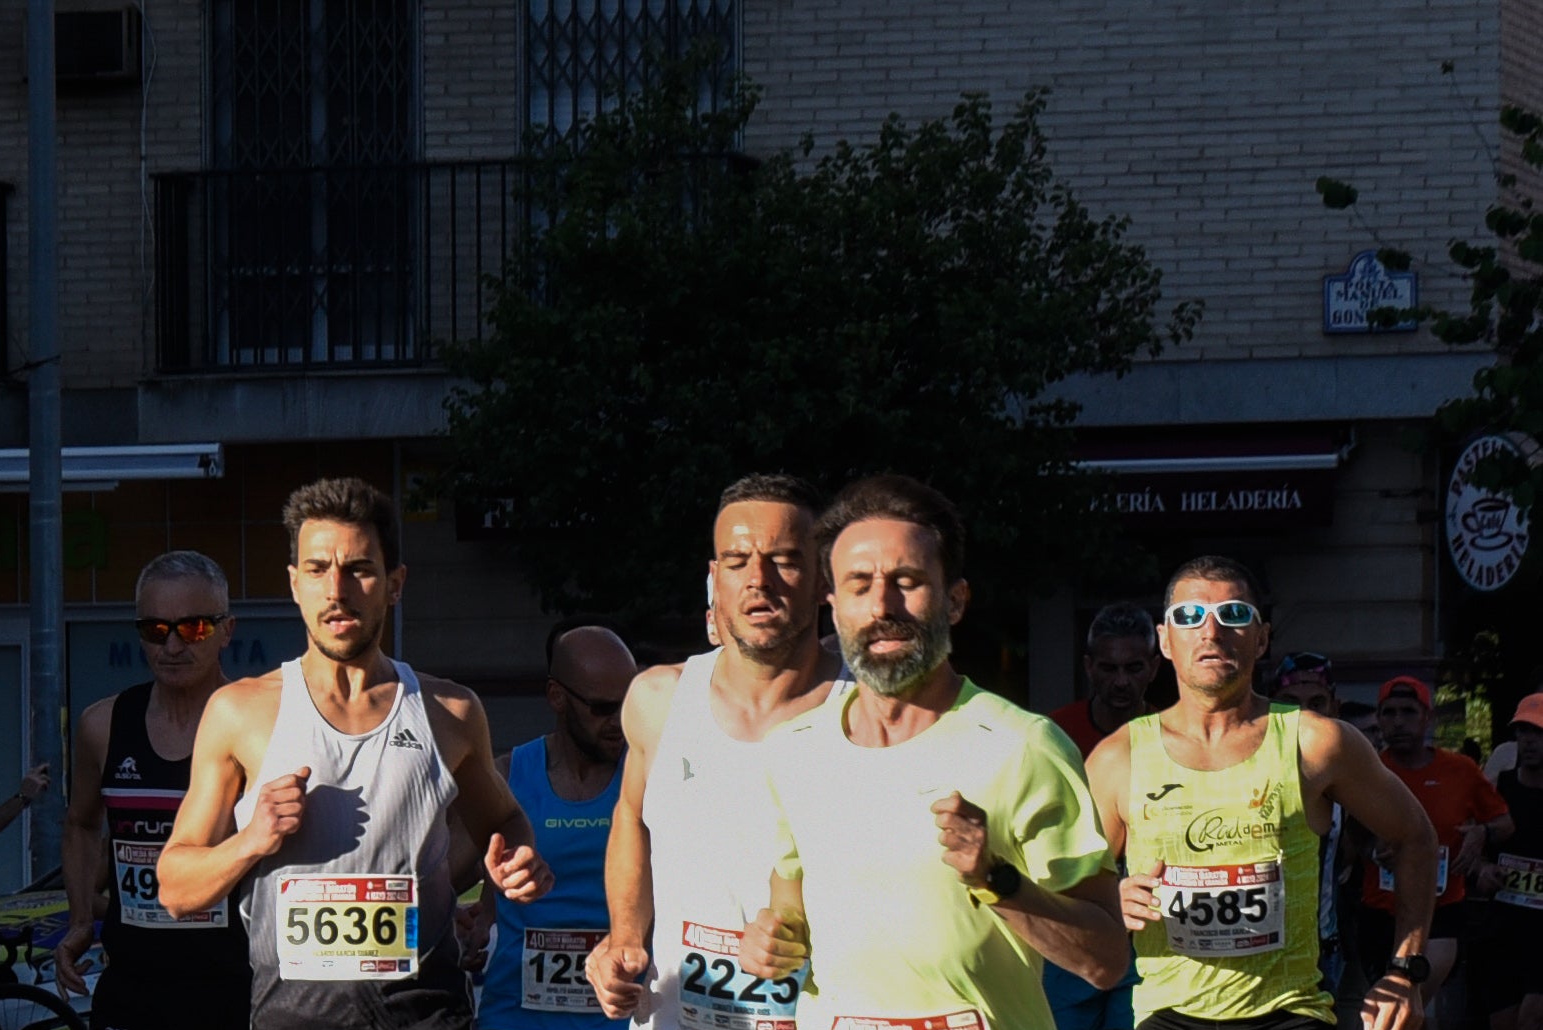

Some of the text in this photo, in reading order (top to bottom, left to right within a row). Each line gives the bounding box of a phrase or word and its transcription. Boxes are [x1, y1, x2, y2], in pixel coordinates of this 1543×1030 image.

[1180, 482, 1303, 512] HELADERÍA
[121, 867, 157, 901] 49
[1168, 887, 1267, 926] 4585
[286, 906, 397, 945] 5636
[530, 932, 545, 949] 40
[684, 952, 799, 1004] 2225
